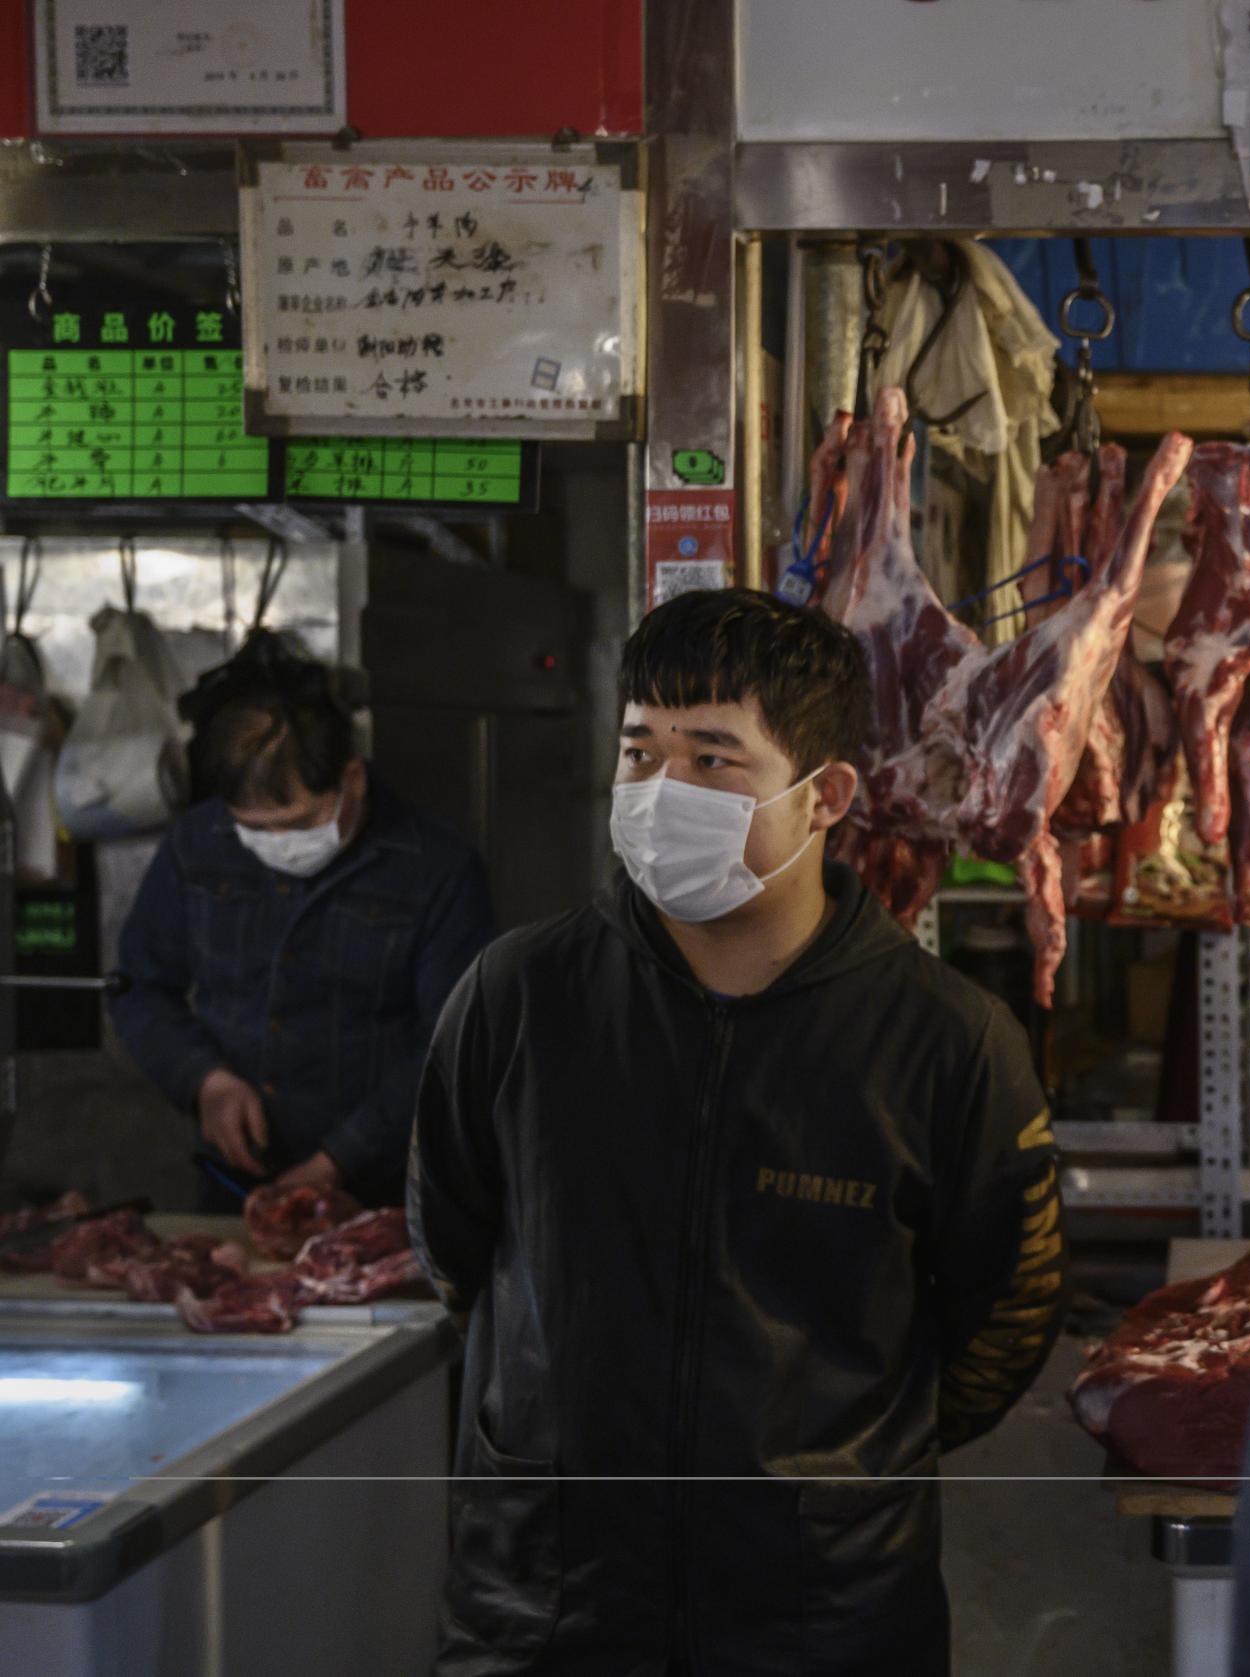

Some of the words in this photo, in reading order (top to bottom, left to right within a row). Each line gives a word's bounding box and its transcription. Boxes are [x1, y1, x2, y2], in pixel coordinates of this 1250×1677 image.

[299, 164, 579, 193] 畜禽产品公示牌
[53, 311, 224, 344] 商品价签
